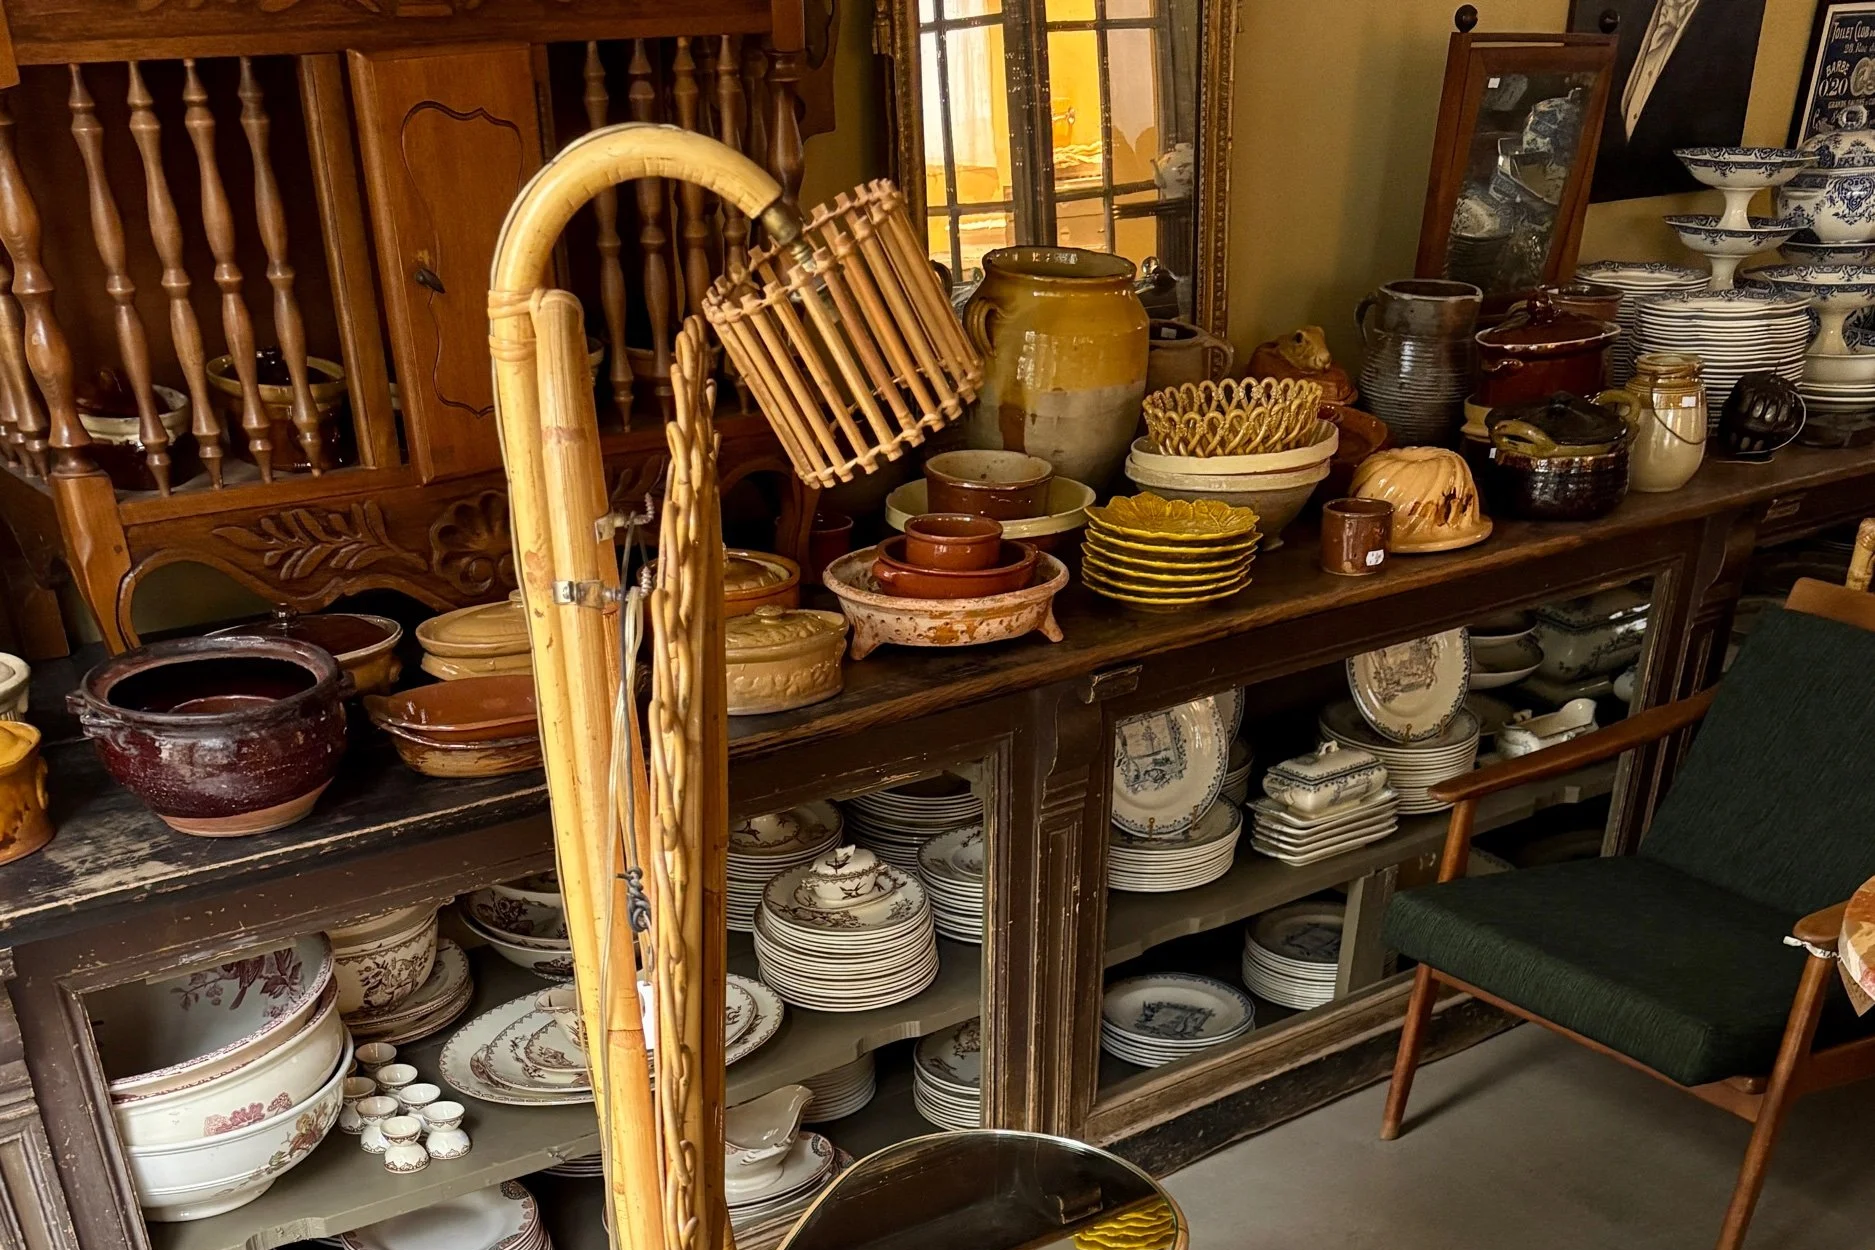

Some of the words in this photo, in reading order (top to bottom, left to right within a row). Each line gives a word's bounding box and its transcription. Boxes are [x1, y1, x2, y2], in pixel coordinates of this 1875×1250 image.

[1832, 22, 1854, 42] TOILET
[1854, 20, 1870, 42] CLUB
[1826, 60, 1850, 77] BARBE
